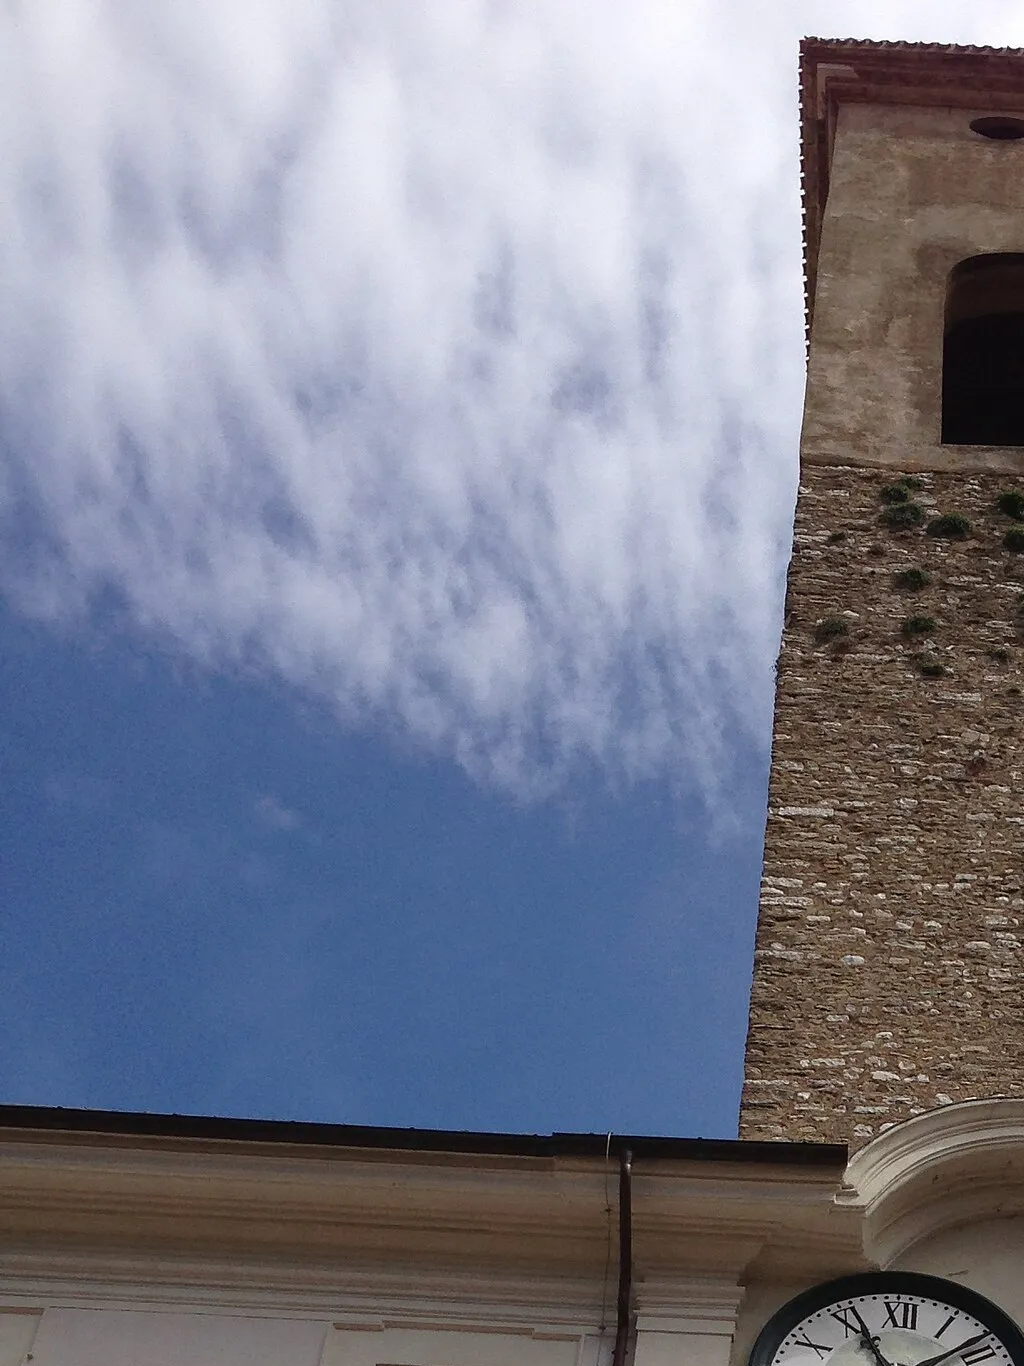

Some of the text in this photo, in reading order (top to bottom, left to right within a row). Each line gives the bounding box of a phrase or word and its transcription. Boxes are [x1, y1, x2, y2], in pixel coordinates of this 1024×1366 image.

[882, 1302, 918, 1330] XII
[795, 1333, 833, 1361] X
[960, 1345, 997, 1366] II
